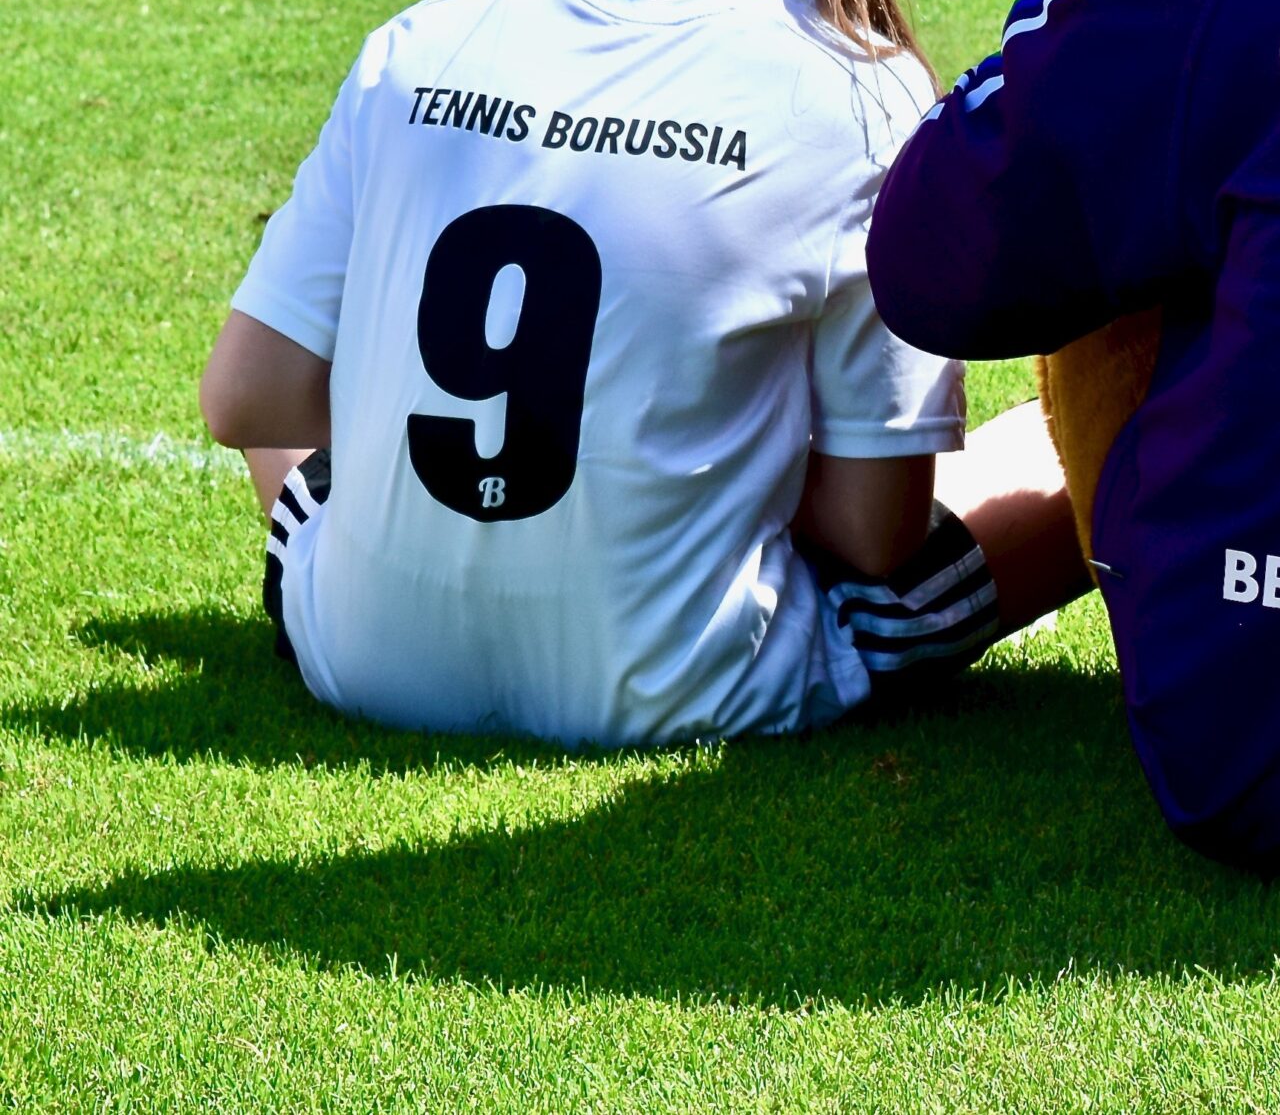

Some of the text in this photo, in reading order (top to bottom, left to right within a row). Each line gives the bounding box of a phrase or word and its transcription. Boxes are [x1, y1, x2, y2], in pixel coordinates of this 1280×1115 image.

[408, 86, 747, 172] TENNIS BORUSSIA
[406, 203, 603, 523] 9
[478, 476, 506, 508] B
